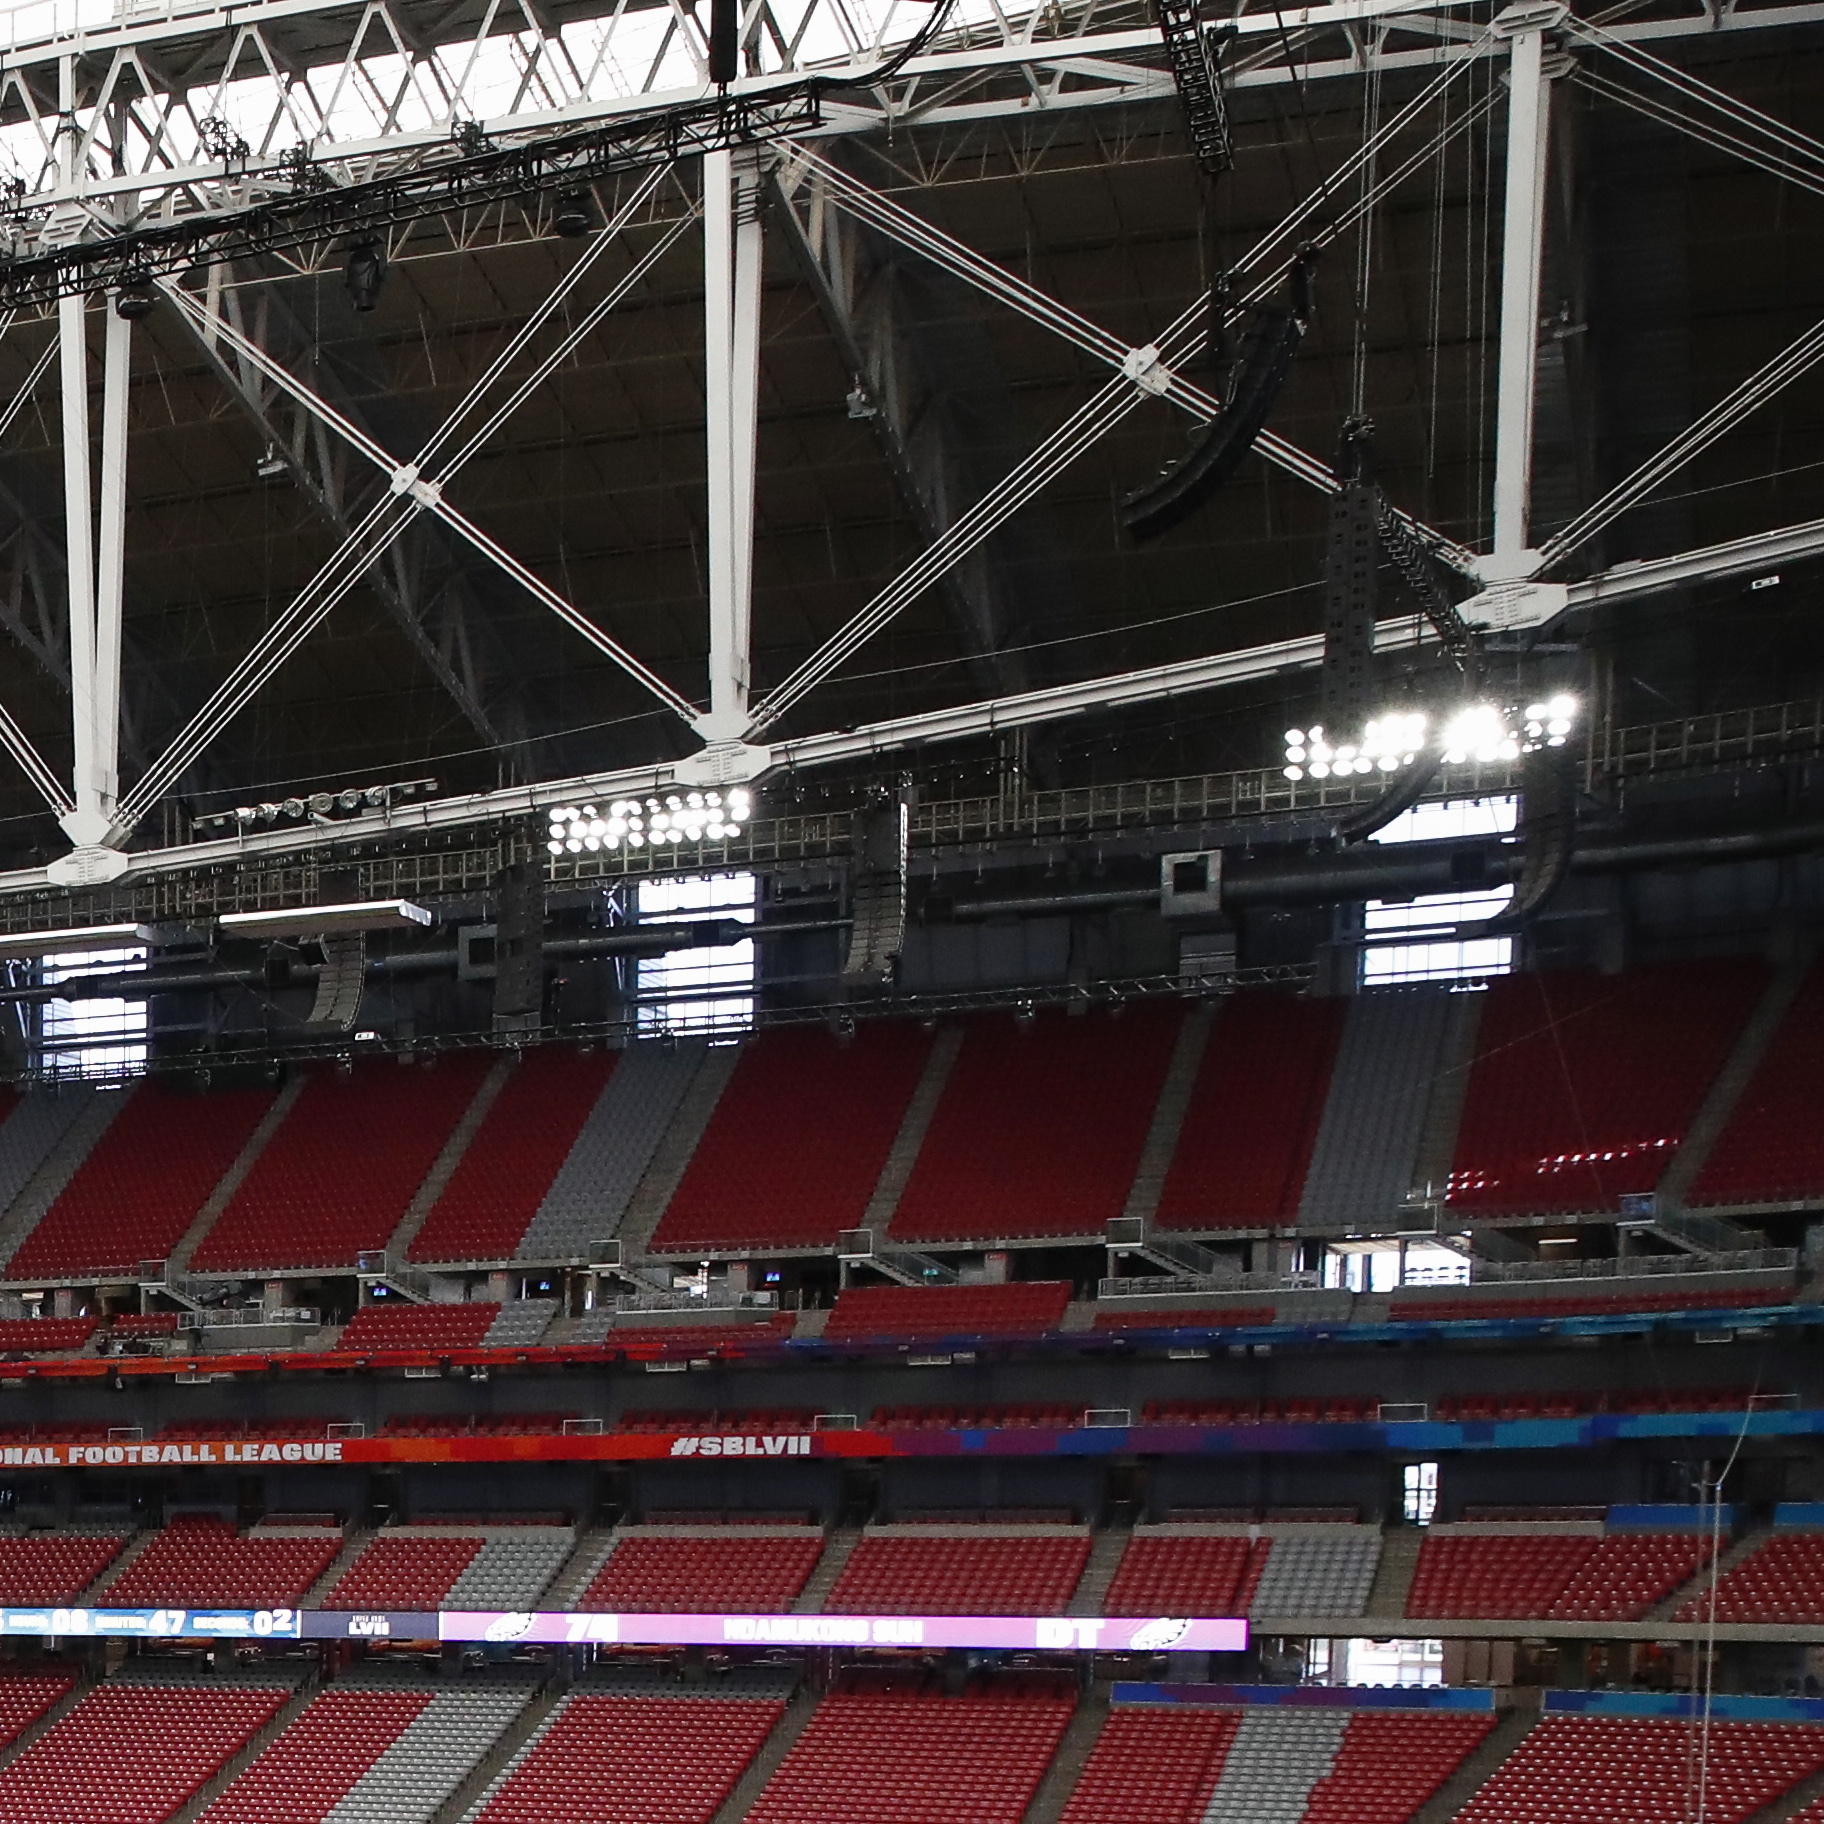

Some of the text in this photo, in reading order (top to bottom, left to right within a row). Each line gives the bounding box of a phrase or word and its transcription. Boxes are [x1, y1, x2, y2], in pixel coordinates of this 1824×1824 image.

[68, 1444, 217, 1465] FOOTBALL
[224, 1442, 343, 1463] LEAGUE
[670, 1435, 812, 1457] #SBLVII
[148, 1610, 185, 1634] 47
[253, 1609, 292, 1635] 02
[348, 1620, 391, 1636] LVII
[1035, 1618, 1106, 1649] DT
